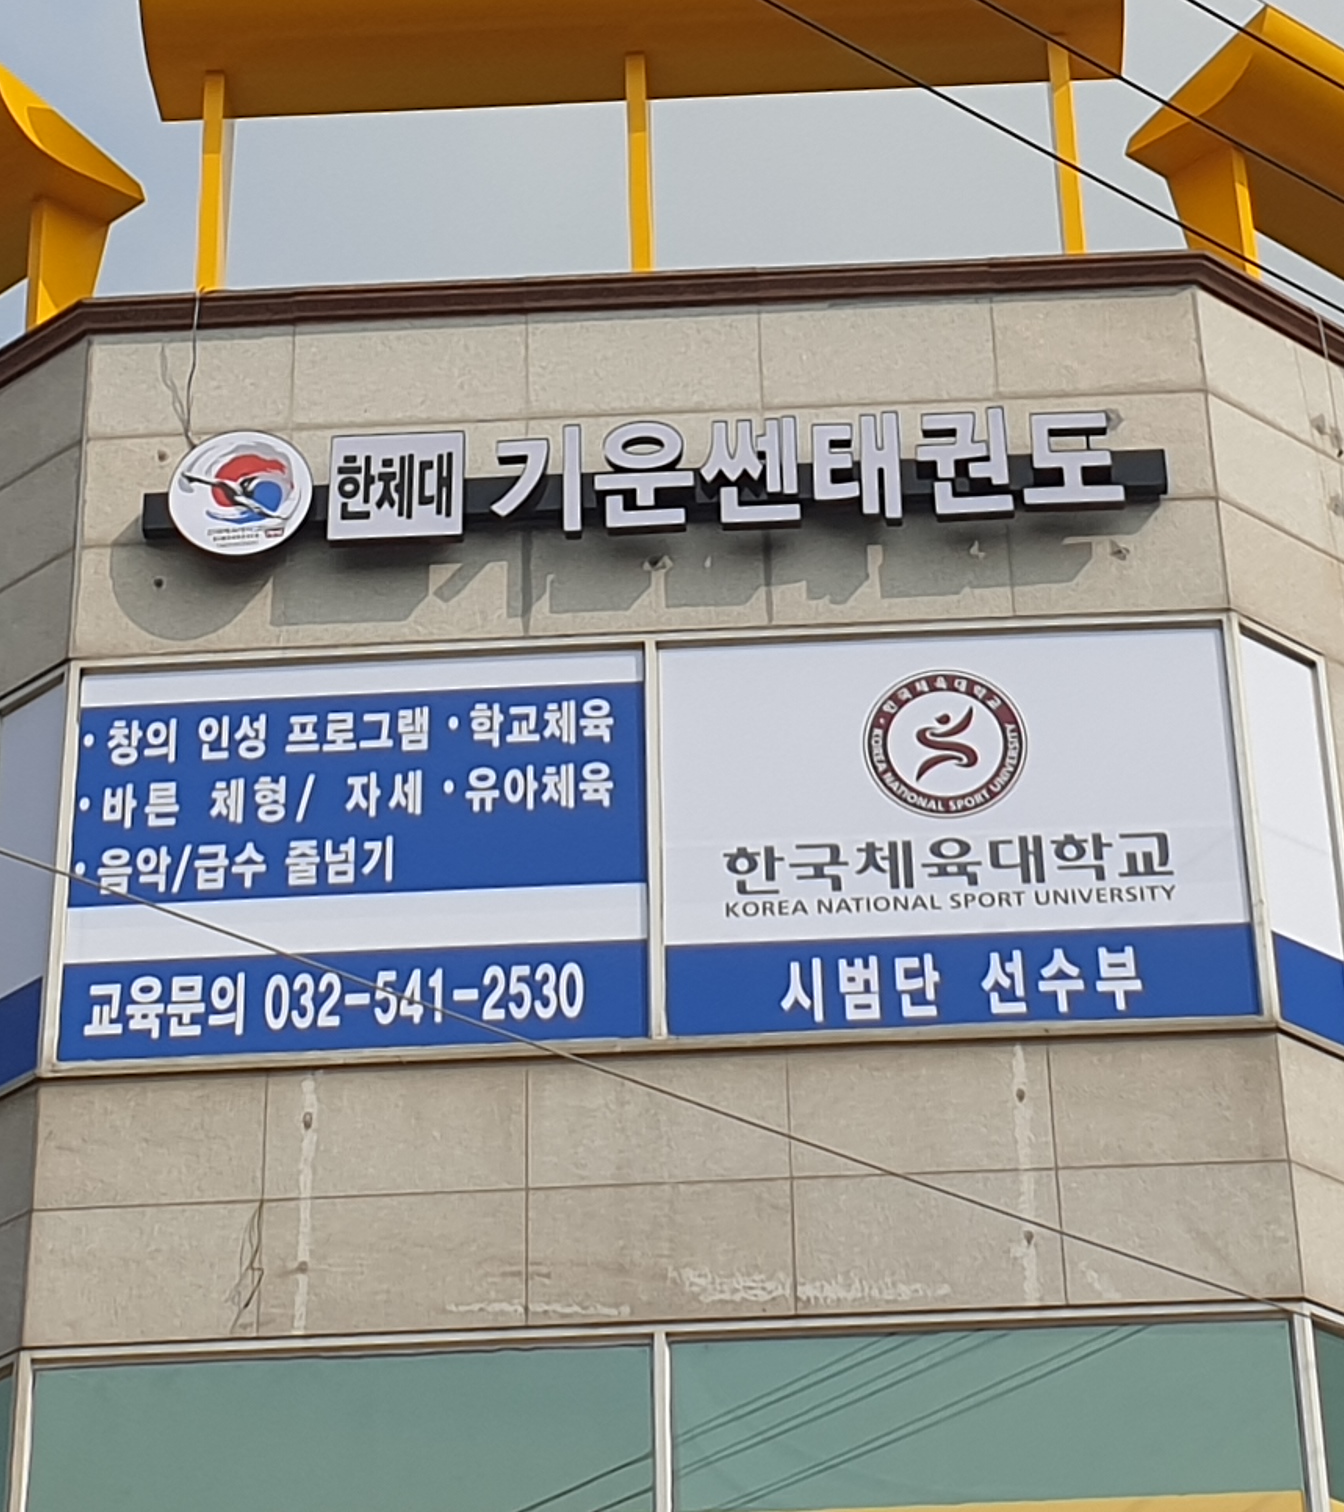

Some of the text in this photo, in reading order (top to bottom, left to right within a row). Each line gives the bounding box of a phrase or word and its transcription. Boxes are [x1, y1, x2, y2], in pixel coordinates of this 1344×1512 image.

[337, 406, 1126, 536] 한체대 기운쎈태권도
[106, 696, 615, 766] 창의 인성 프로그램 학교체육
[102, 781, 180, 828] 바른
[345, 769, 423, 817] 자세
[465, 760, 614, 813] 유아체육
[883, 772, 945, 811] NATIONAL
[948, 791, 991, 811] SPORT
[285, 835, 395, 887] 줄넘기
[722, 831, 1175, 895] 한국체육대학교
[725, 884, 1176, 919] KOREA NATIONAL SPORT UNIVERSITY
[83, 961, 585, 1039] 교육문의 032-541-2530
[780, 945, 1143, 1023] 시범단 선수부
